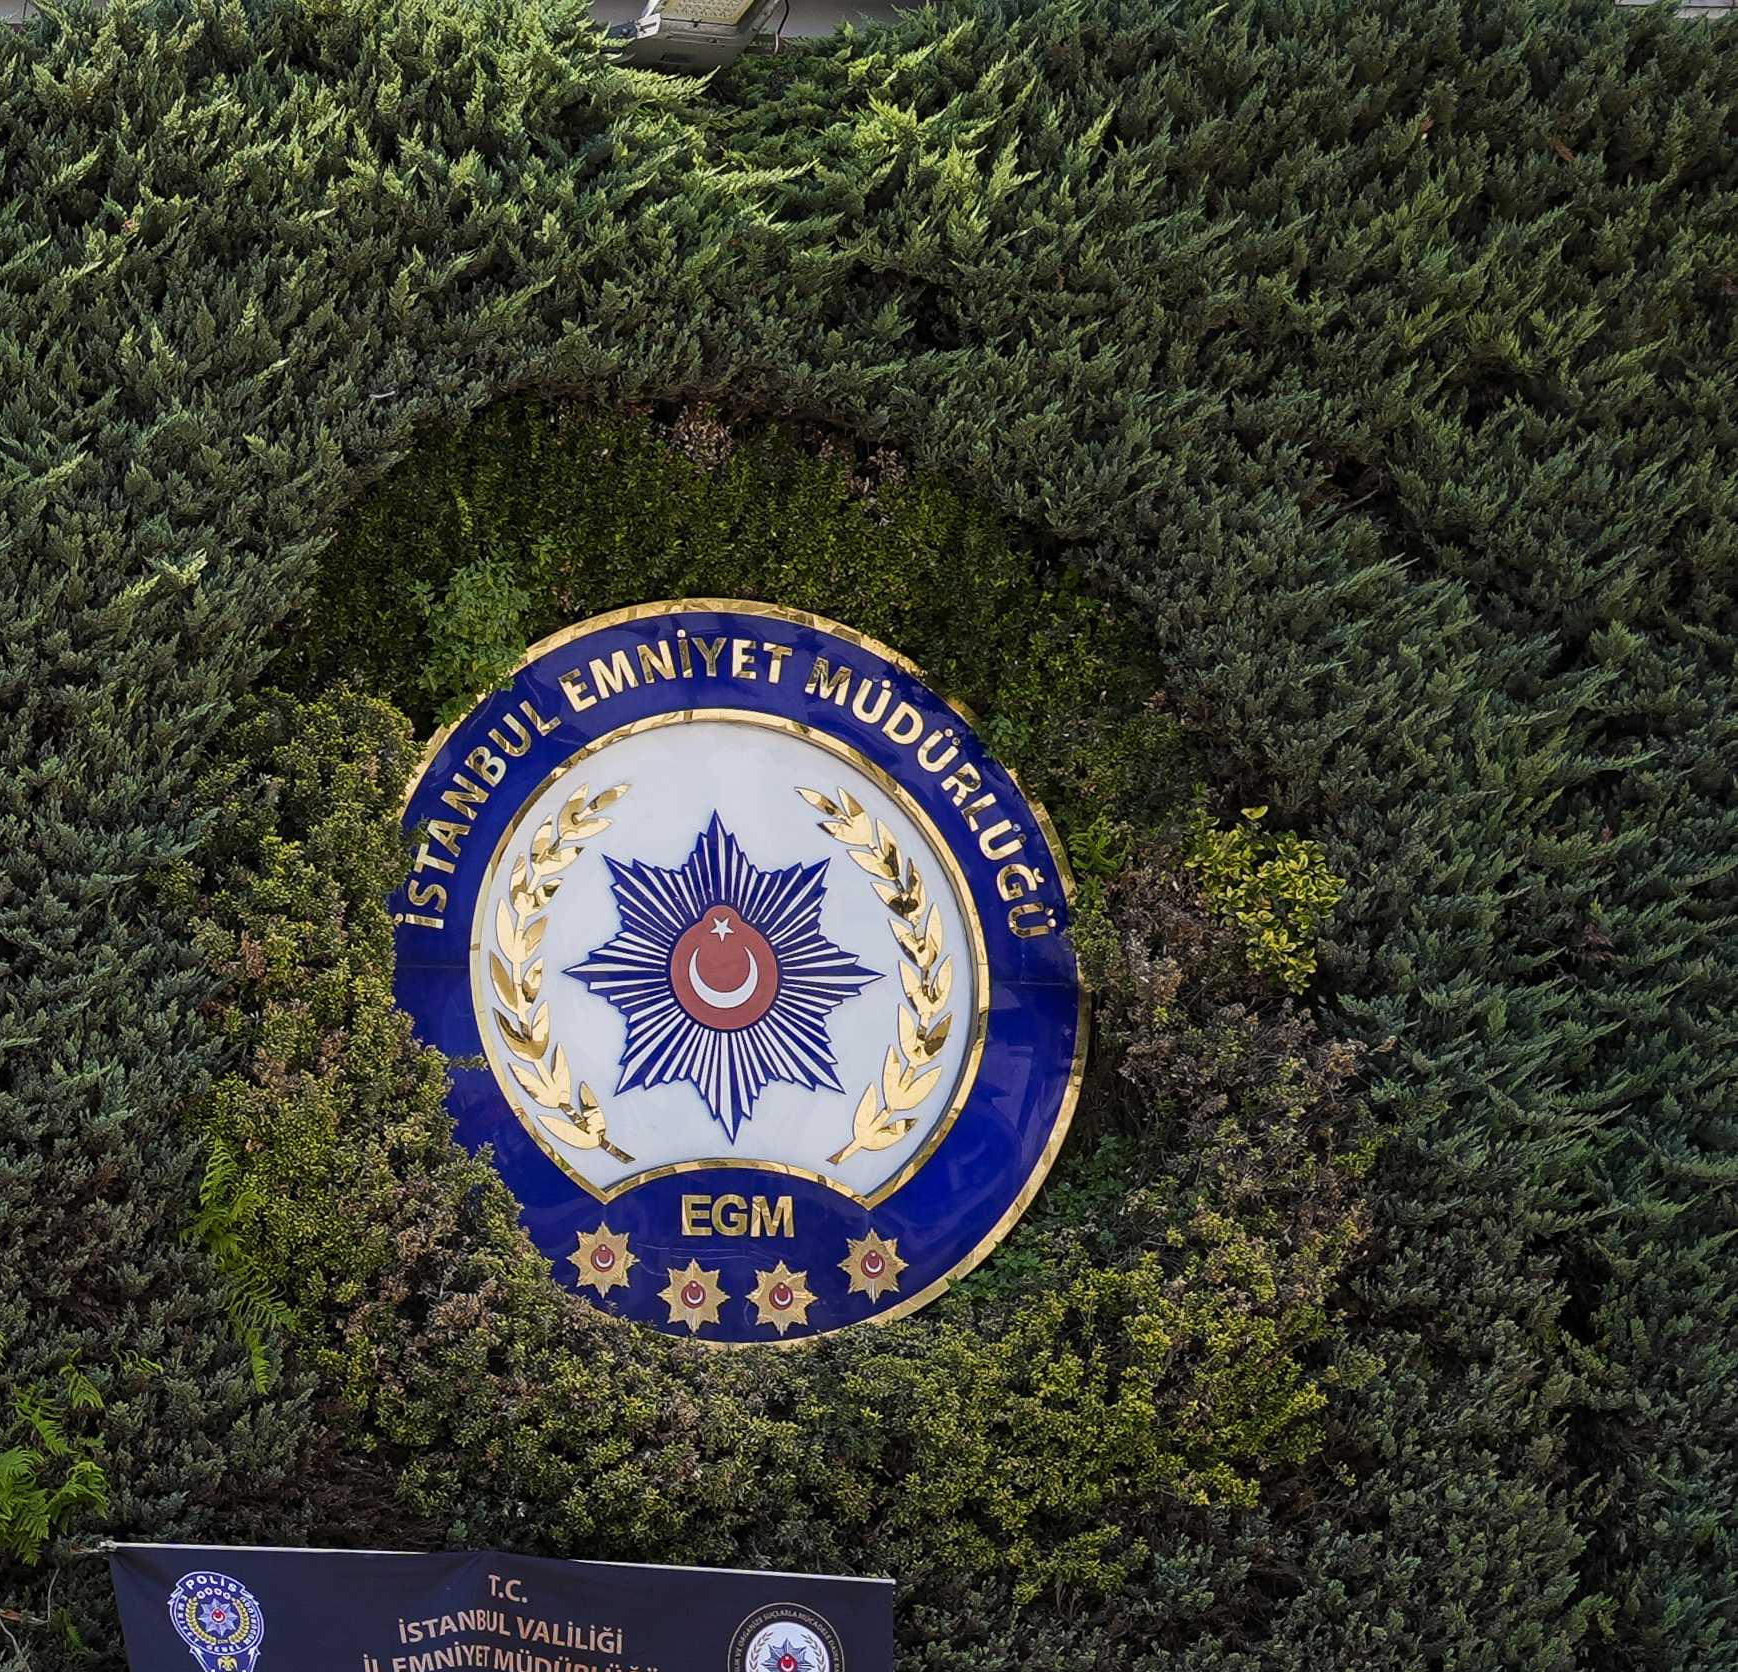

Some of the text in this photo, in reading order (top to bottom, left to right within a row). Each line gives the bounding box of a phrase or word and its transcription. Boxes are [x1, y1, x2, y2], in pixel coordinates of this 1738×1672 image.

[394, 628, 1058, 941] İSTANBUL EMNİYET MÜDÜRLÜĞÜ
[681, 1194, 795, 1239] EGM
[488, 1573, 528, 1604] T.C.
[398, 1608, 624, 1655] İSTANBUL VALİLİĞİ
